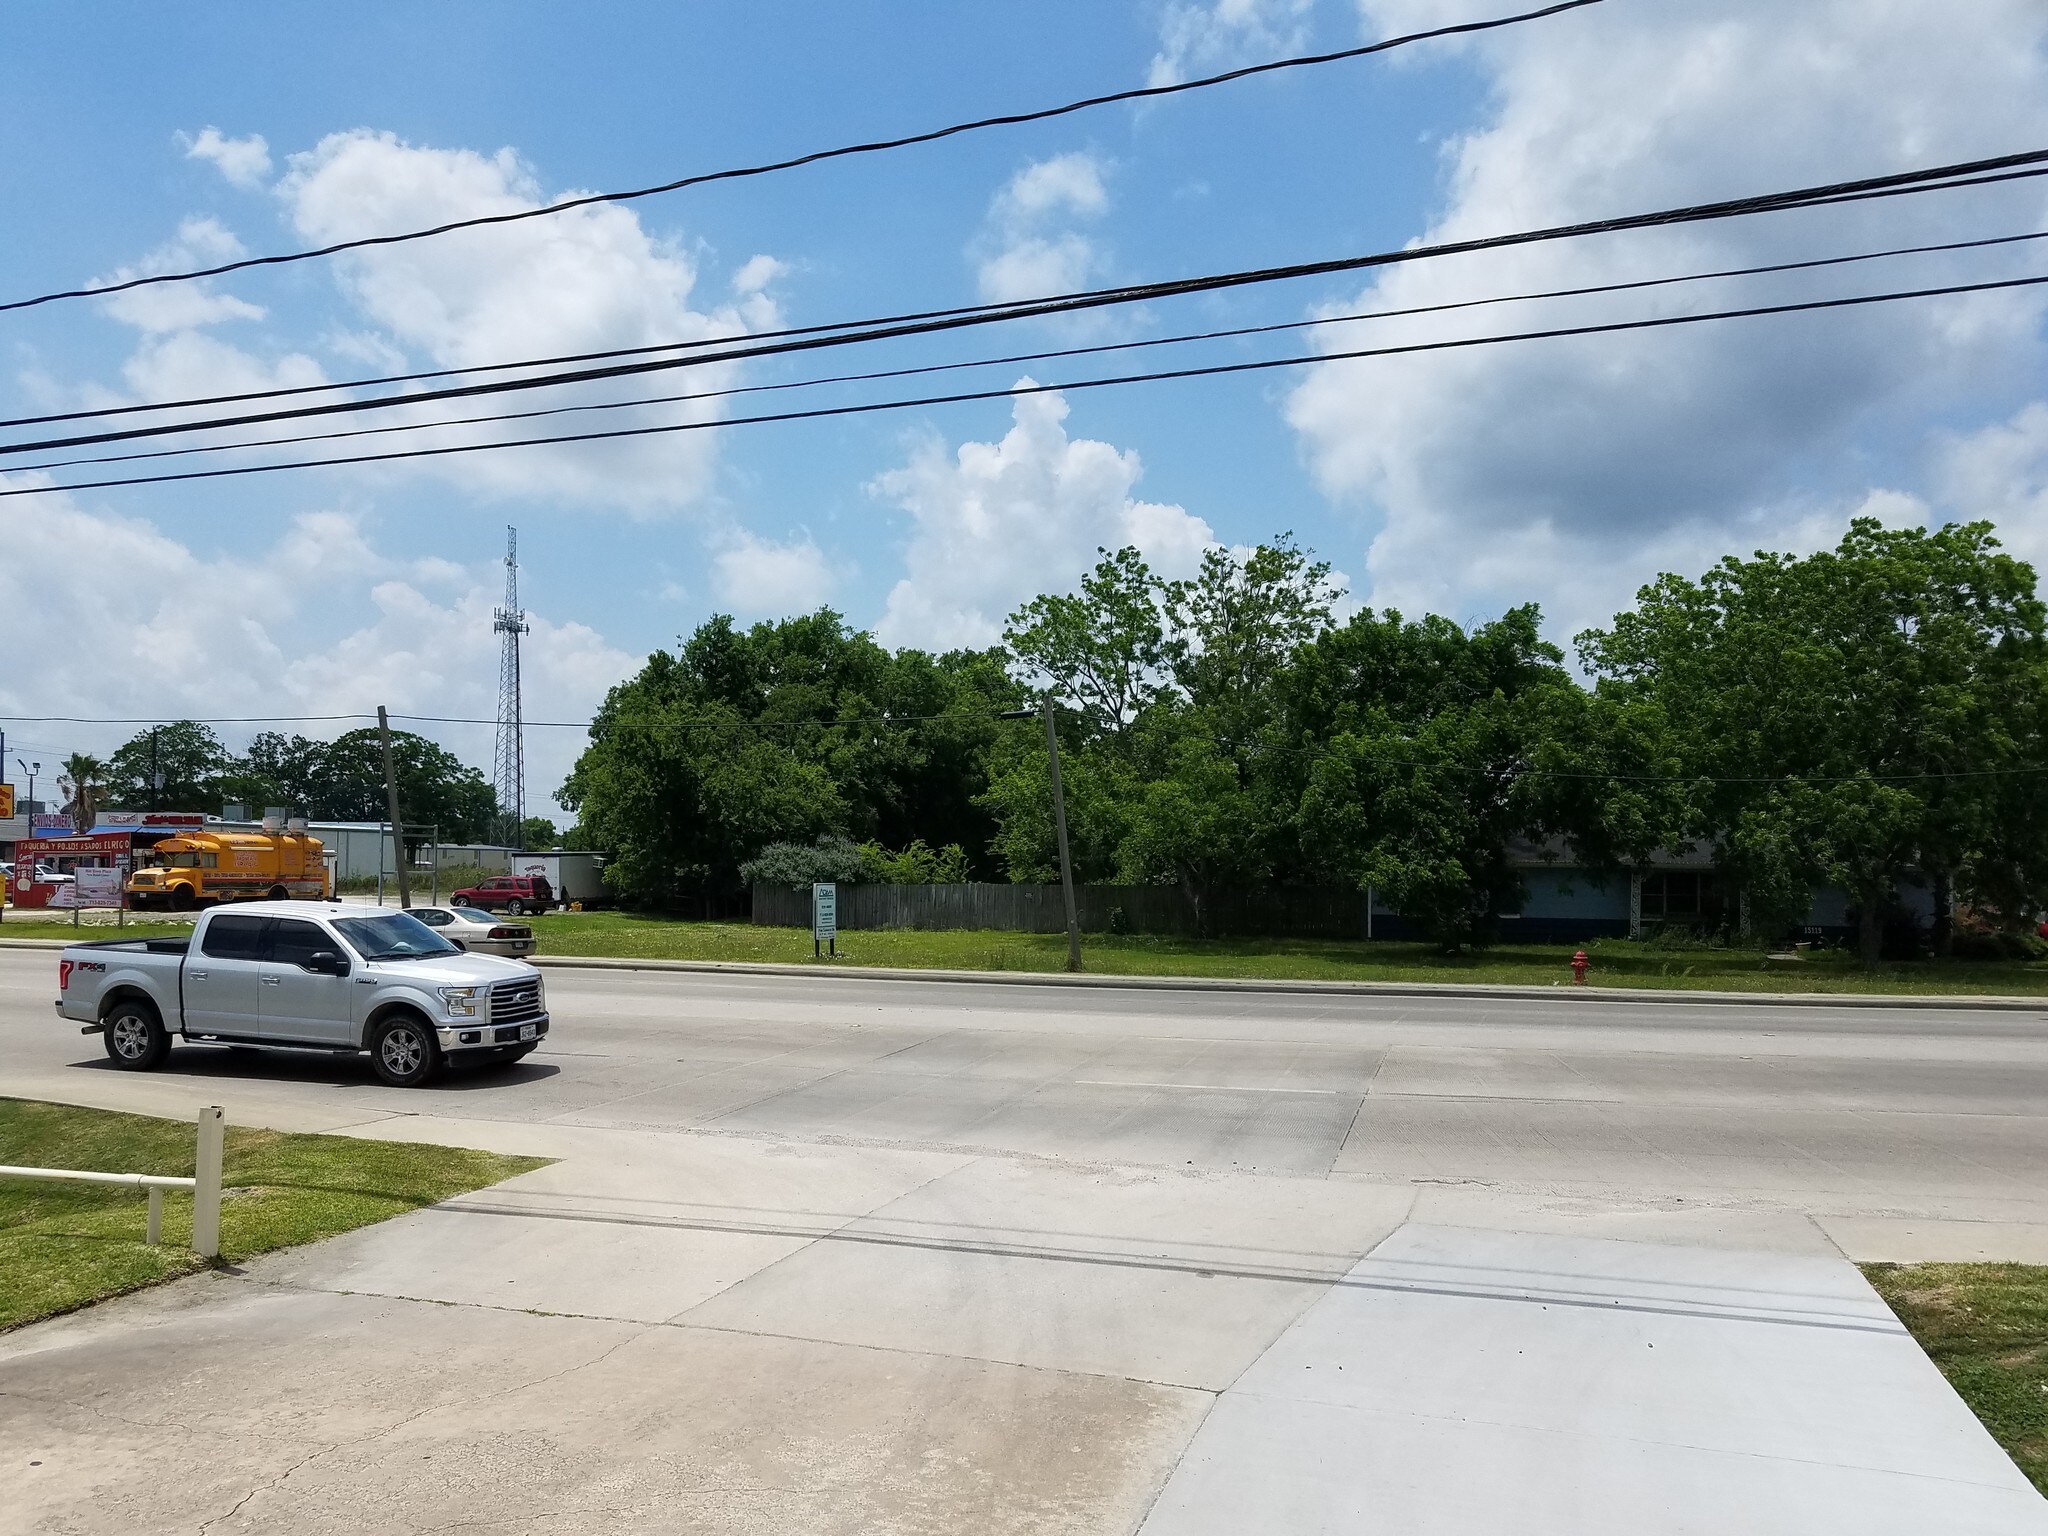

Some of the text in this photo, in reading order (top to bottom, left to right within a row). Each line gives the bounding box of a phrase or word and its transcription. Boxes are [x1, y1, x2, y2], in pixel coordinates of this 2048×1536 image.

[20, 842, 49, 850] TAQUERIA
[52, 842, 56, 850] Y
[57, 842, 79, 850] POLLOS
[80, 841, 102, 849] ASADOS
[1804, 926, 1822, 934] 15119
[78, 962, 106, 972] FX4
